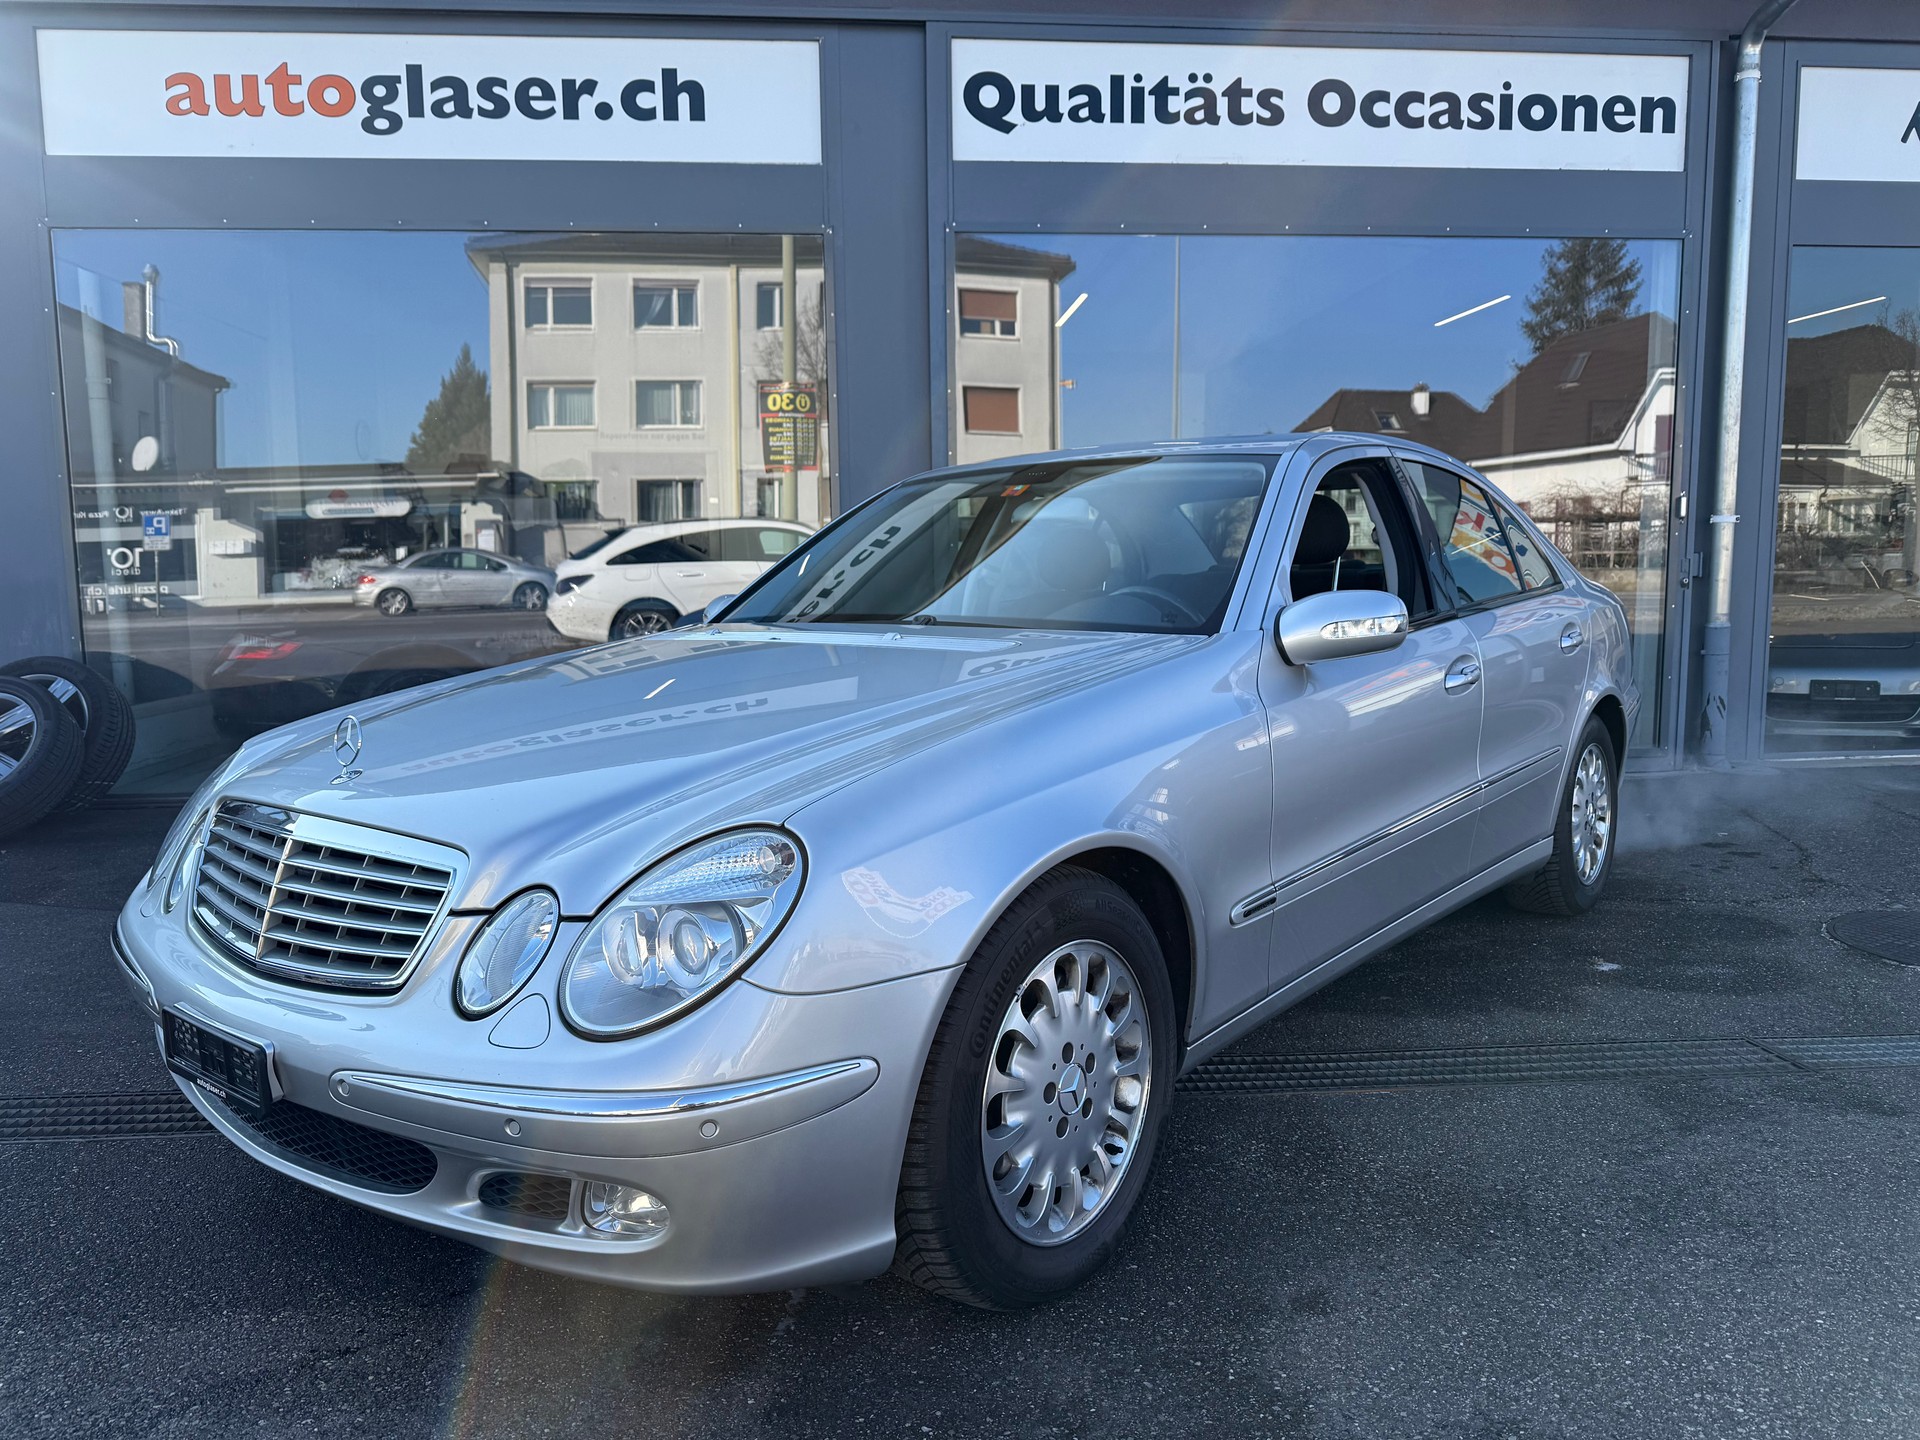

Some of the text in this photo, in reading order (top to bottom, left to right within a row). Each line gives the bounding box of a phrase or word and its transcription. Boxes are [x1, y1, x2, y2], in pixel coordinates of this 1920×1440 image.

[164, 61, 706, 136] autoglaser.ch
[962, 70, 1677, 135] Qualitäts Occasionen
